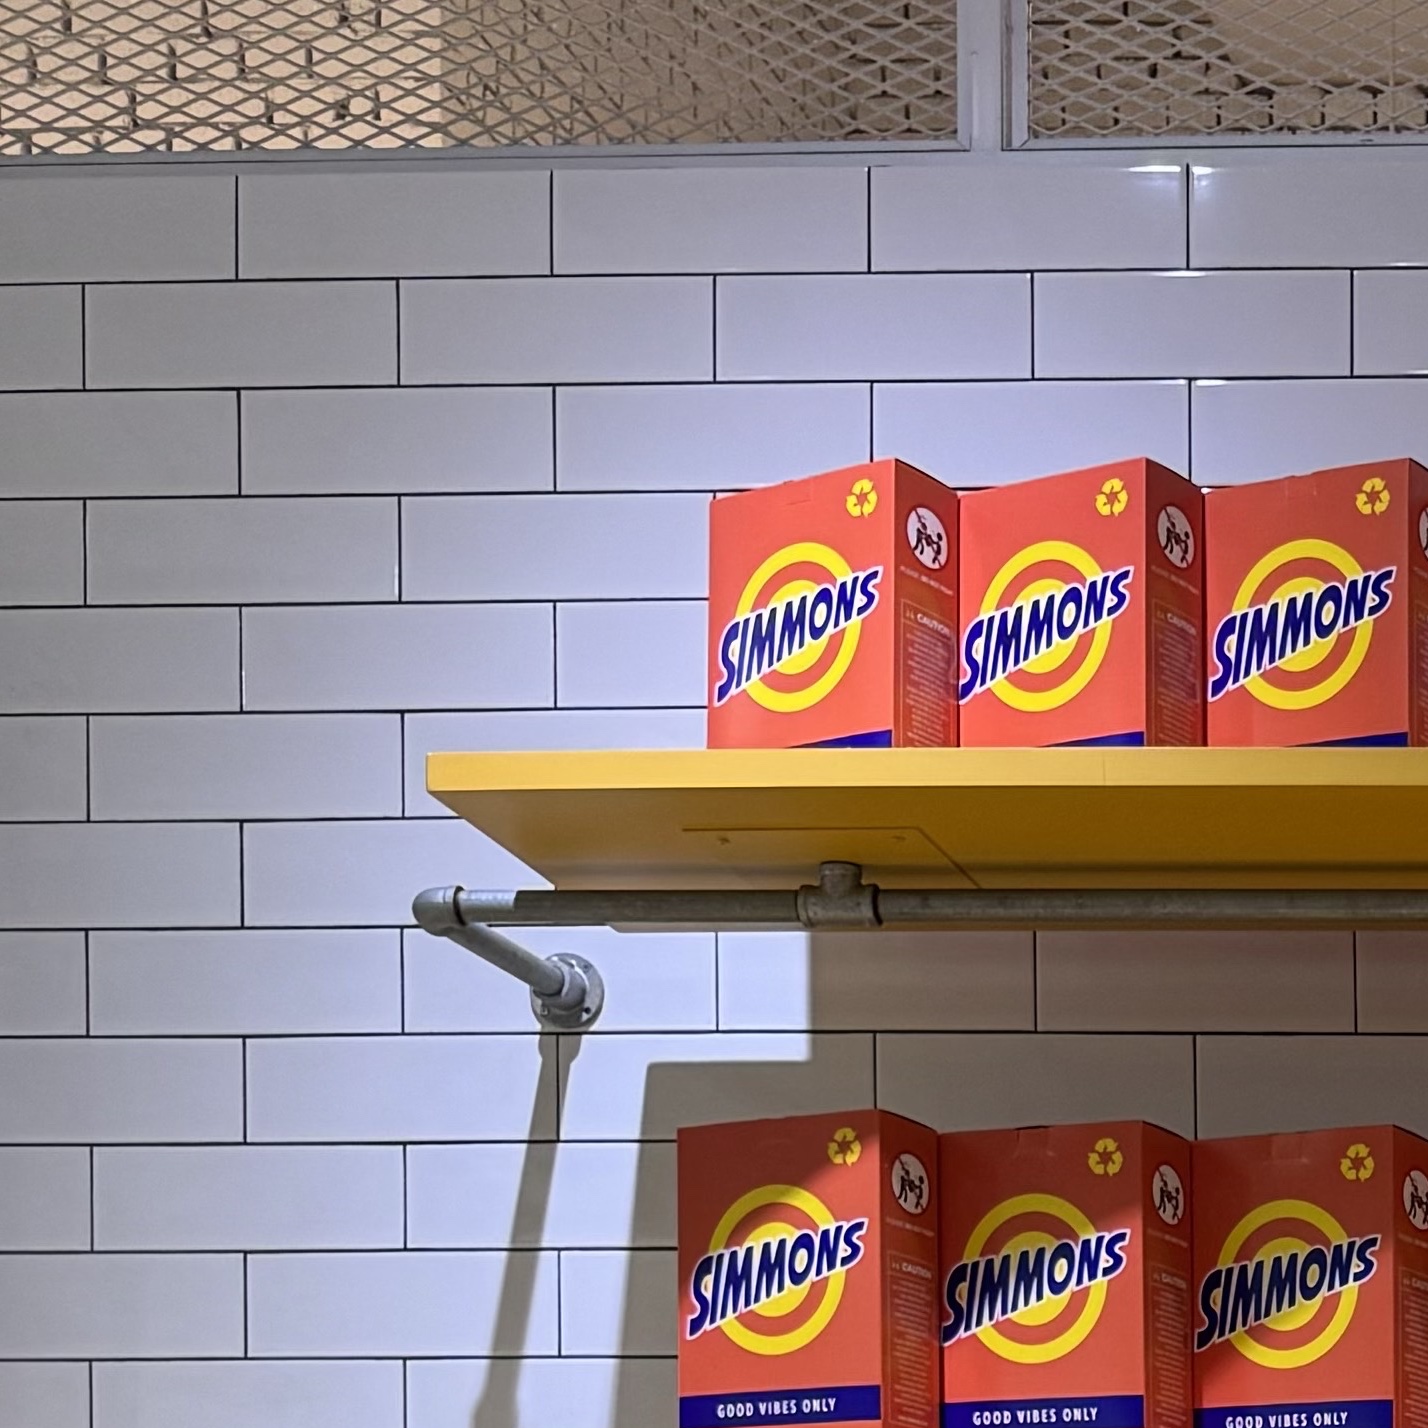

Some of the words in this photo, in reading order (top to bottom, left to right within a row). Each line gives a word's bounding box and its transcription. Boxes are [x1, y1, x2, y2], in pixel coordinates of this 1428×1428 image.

[714, 567, 883, 704] SIMMONS
[957, 567, 1134, 703] SIMMONS
[1208, 566, 1397, 701] SIMMONS
[686, 1218, 868, 1340] SIMMONS
[938, 1229, 1131, 1347] SIMMONS
[1196, 1235, 1381, 1349] SIMMONS
[716, 1402, 754, 1419] GOOD
[758, 1399, 797, 1416] VIBES
[801, 1397, 837, 1414] ONLY
[972, 1410, 1012, 1426] GOOD
[1016, 1407, 1057, 1424] VIBES
[1062, 1407, 1098, 1422] ONLY
[1268, 1413, 1308, 1428] VIBES
[1312, 1411, 1348, 1427] ONLY
